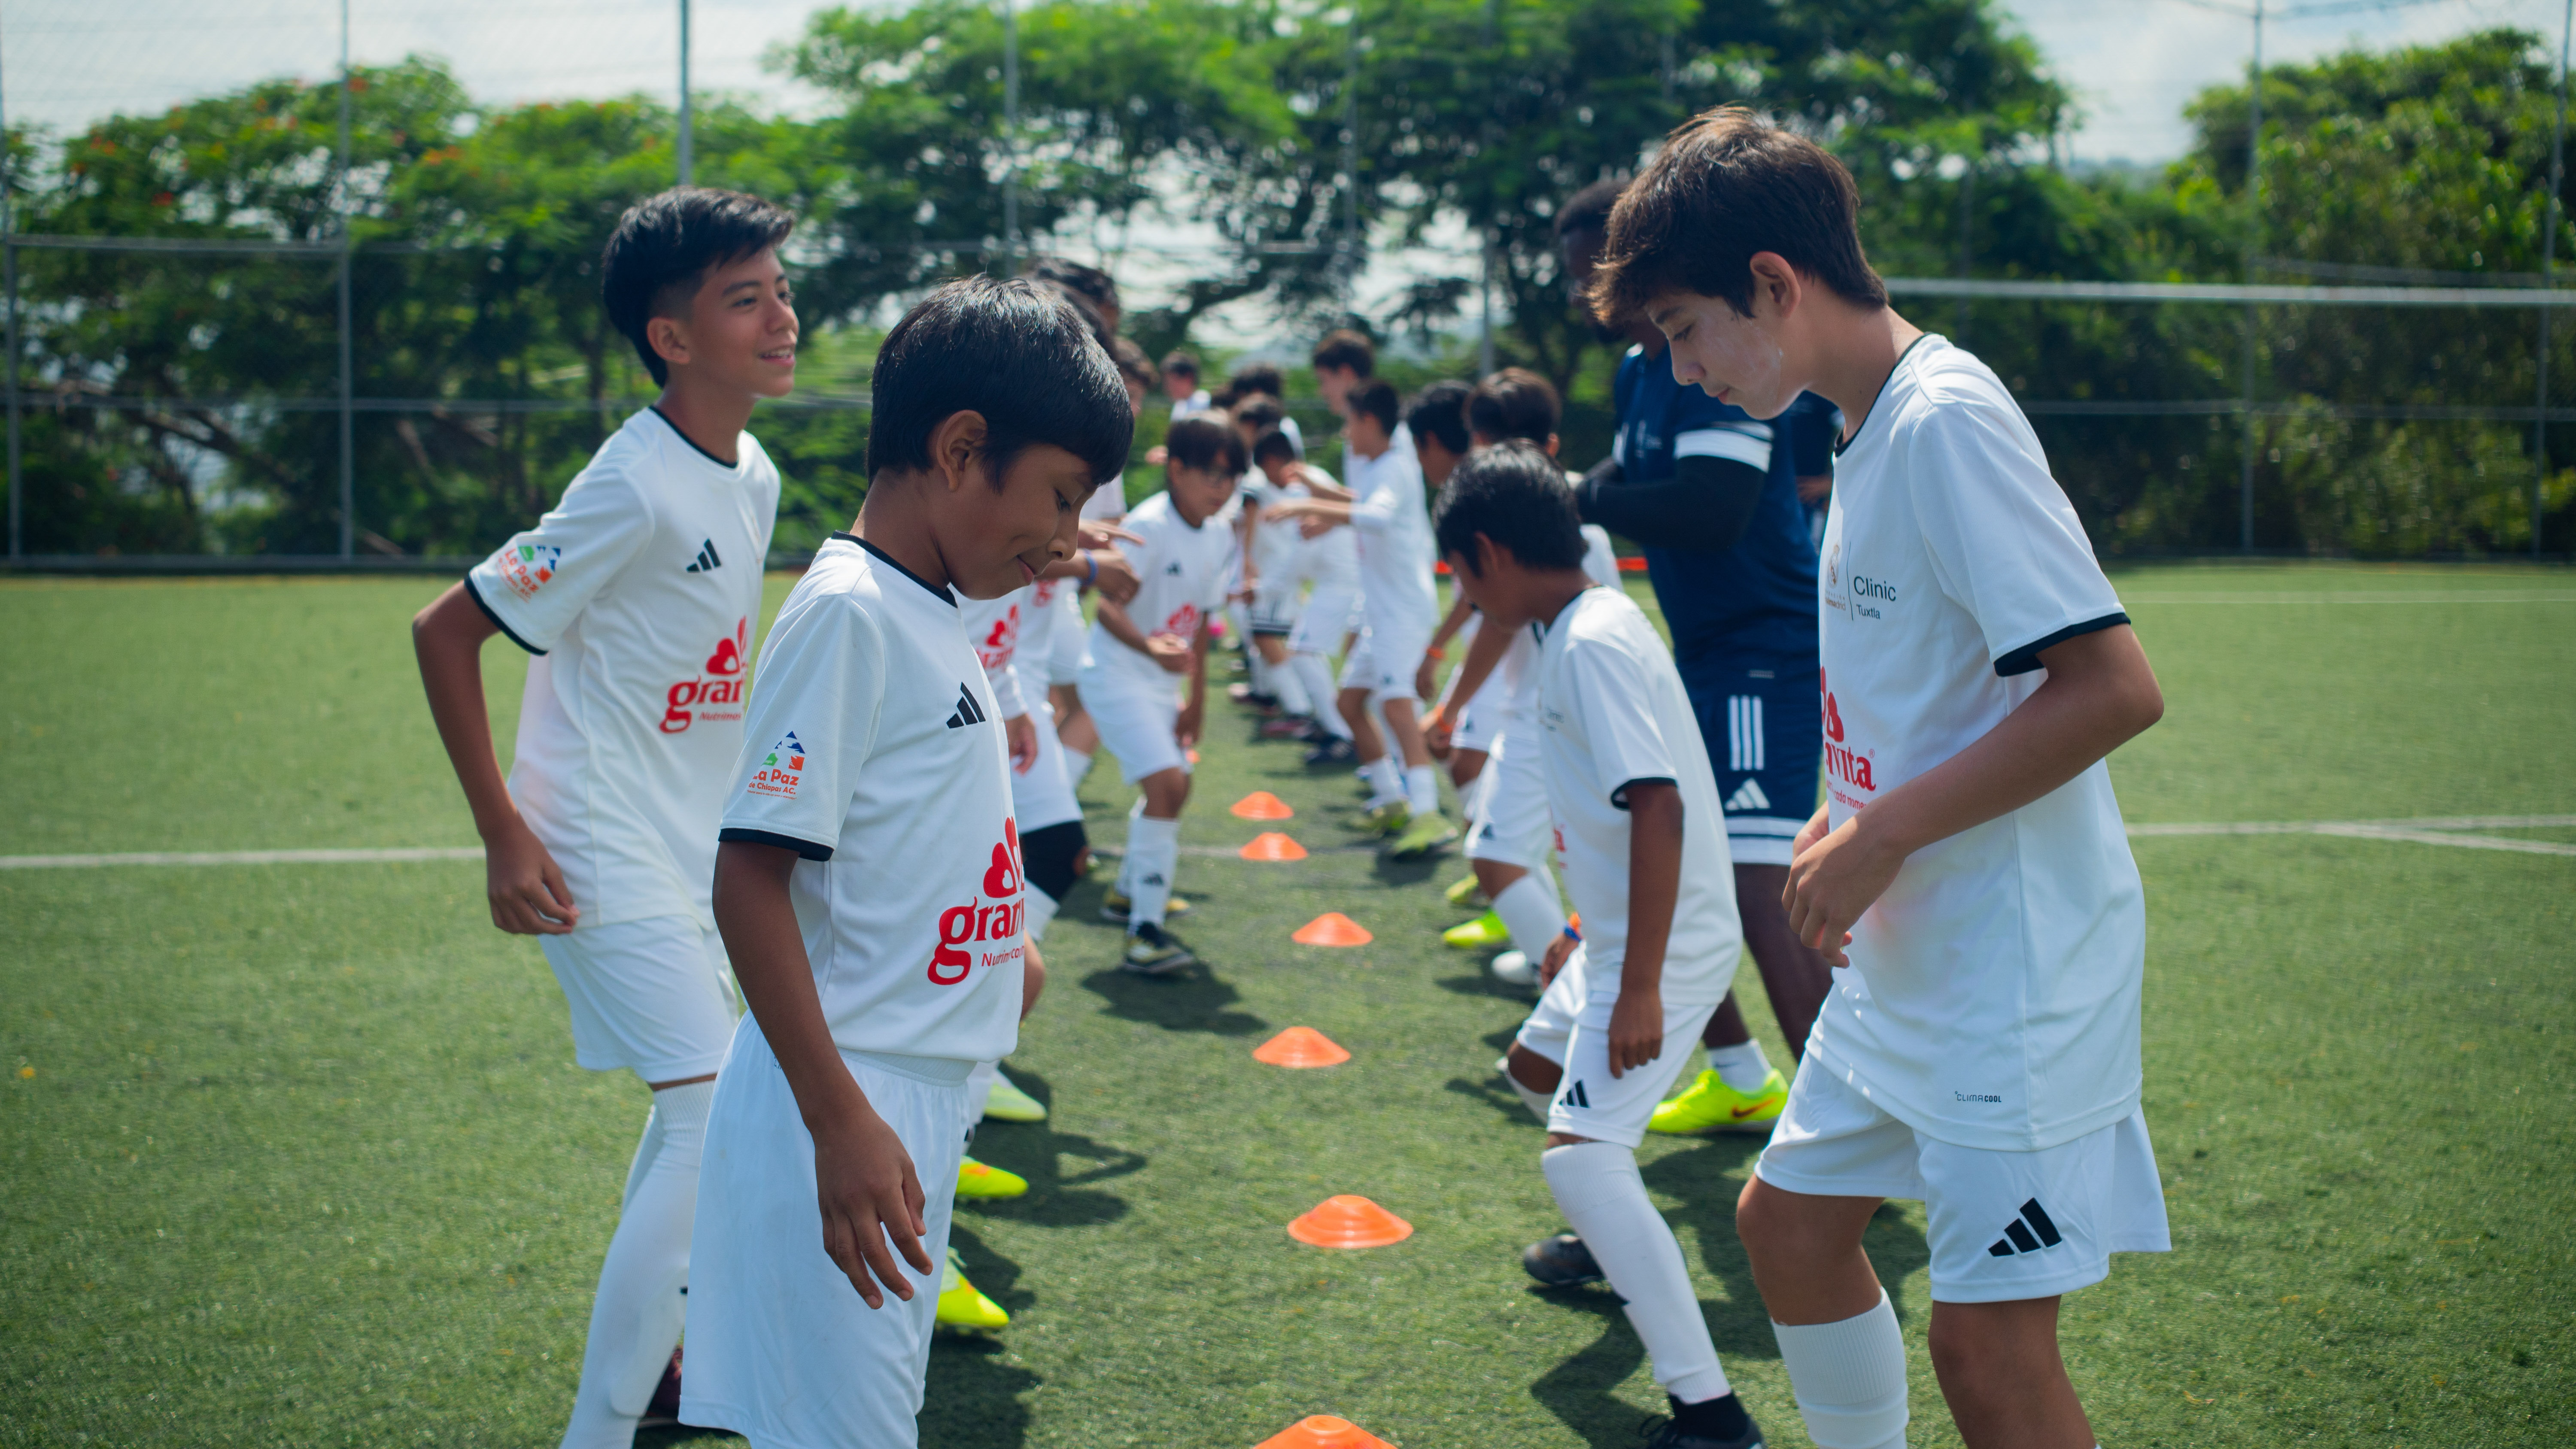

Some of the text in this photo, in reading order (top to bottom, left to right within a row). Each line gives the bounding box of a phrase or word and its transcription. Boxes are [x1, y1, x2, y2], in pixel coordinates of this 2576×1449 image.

[514, 564, 540, 593] Paz
[1853, 576, 1896, 602] Clinic
[1856, 603, 1880, 619] Tuxtla
[771, 769, 799, 786] Paz
[757, 782, 781, 792] Chiapas
[782, 786, 796, 794] AC.
